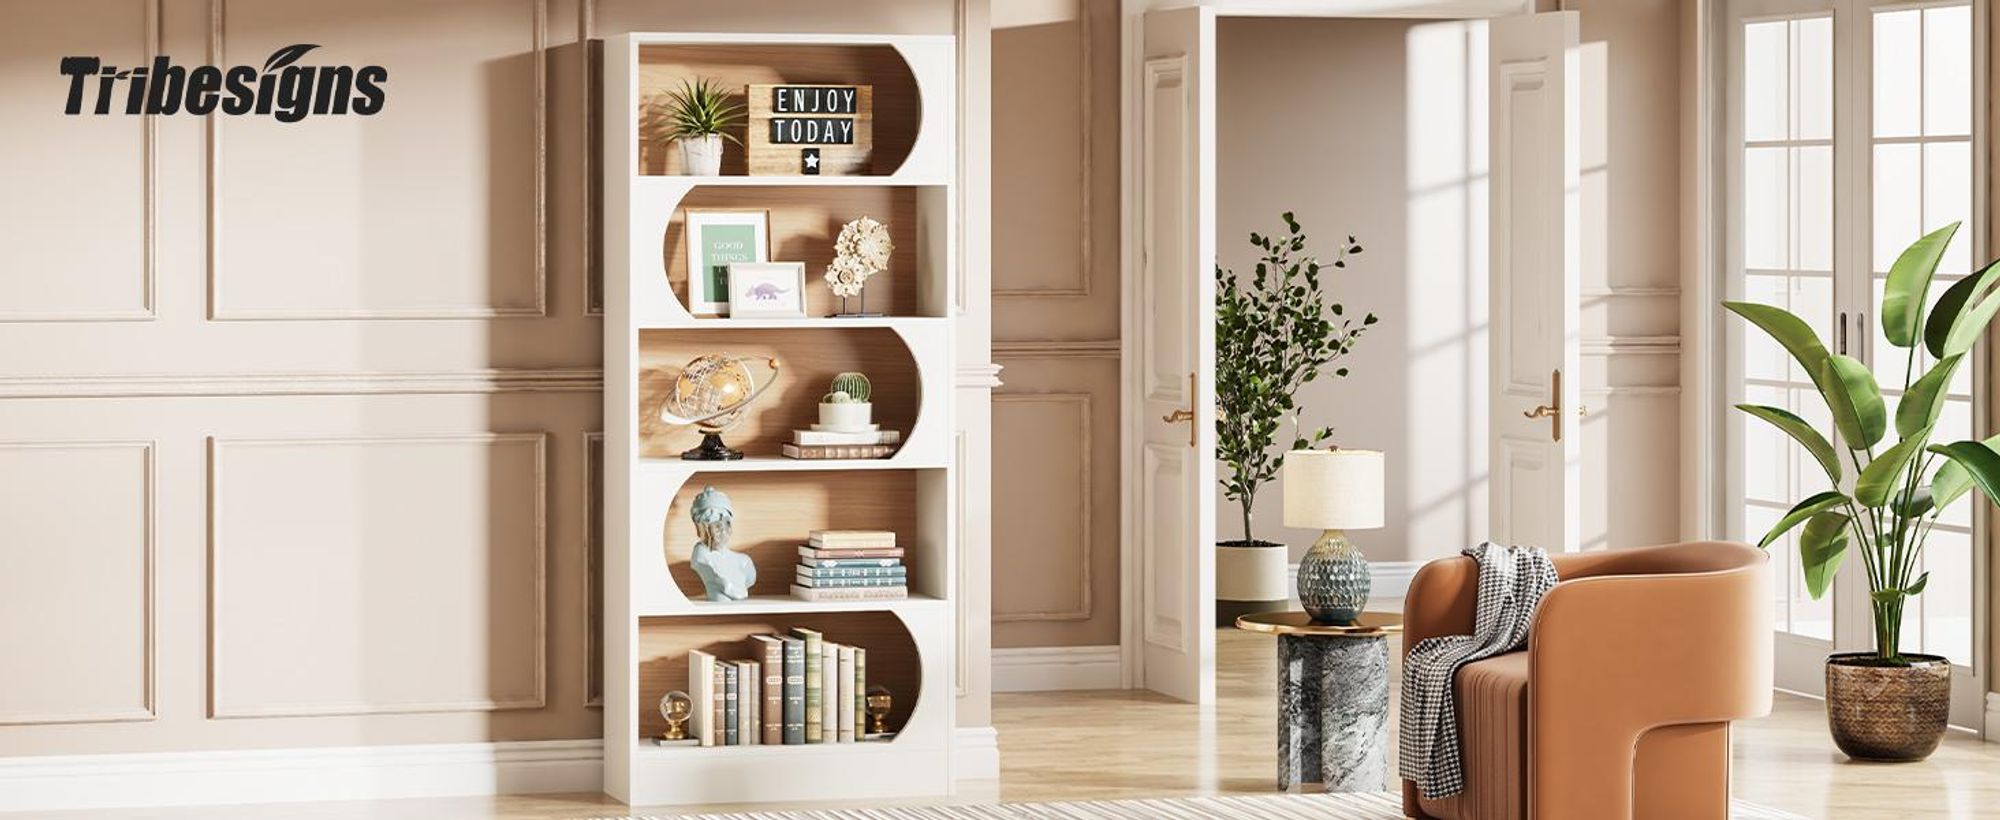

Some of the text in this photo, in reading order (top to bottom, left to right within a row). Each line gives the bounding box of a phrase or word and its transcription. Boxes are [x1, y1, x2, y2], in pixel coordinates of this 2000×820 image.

[778, 88, 854, 112] ENJOY
[774, 119, 852, 143] TODAY
[713, 241, 744, 250] GOOD
